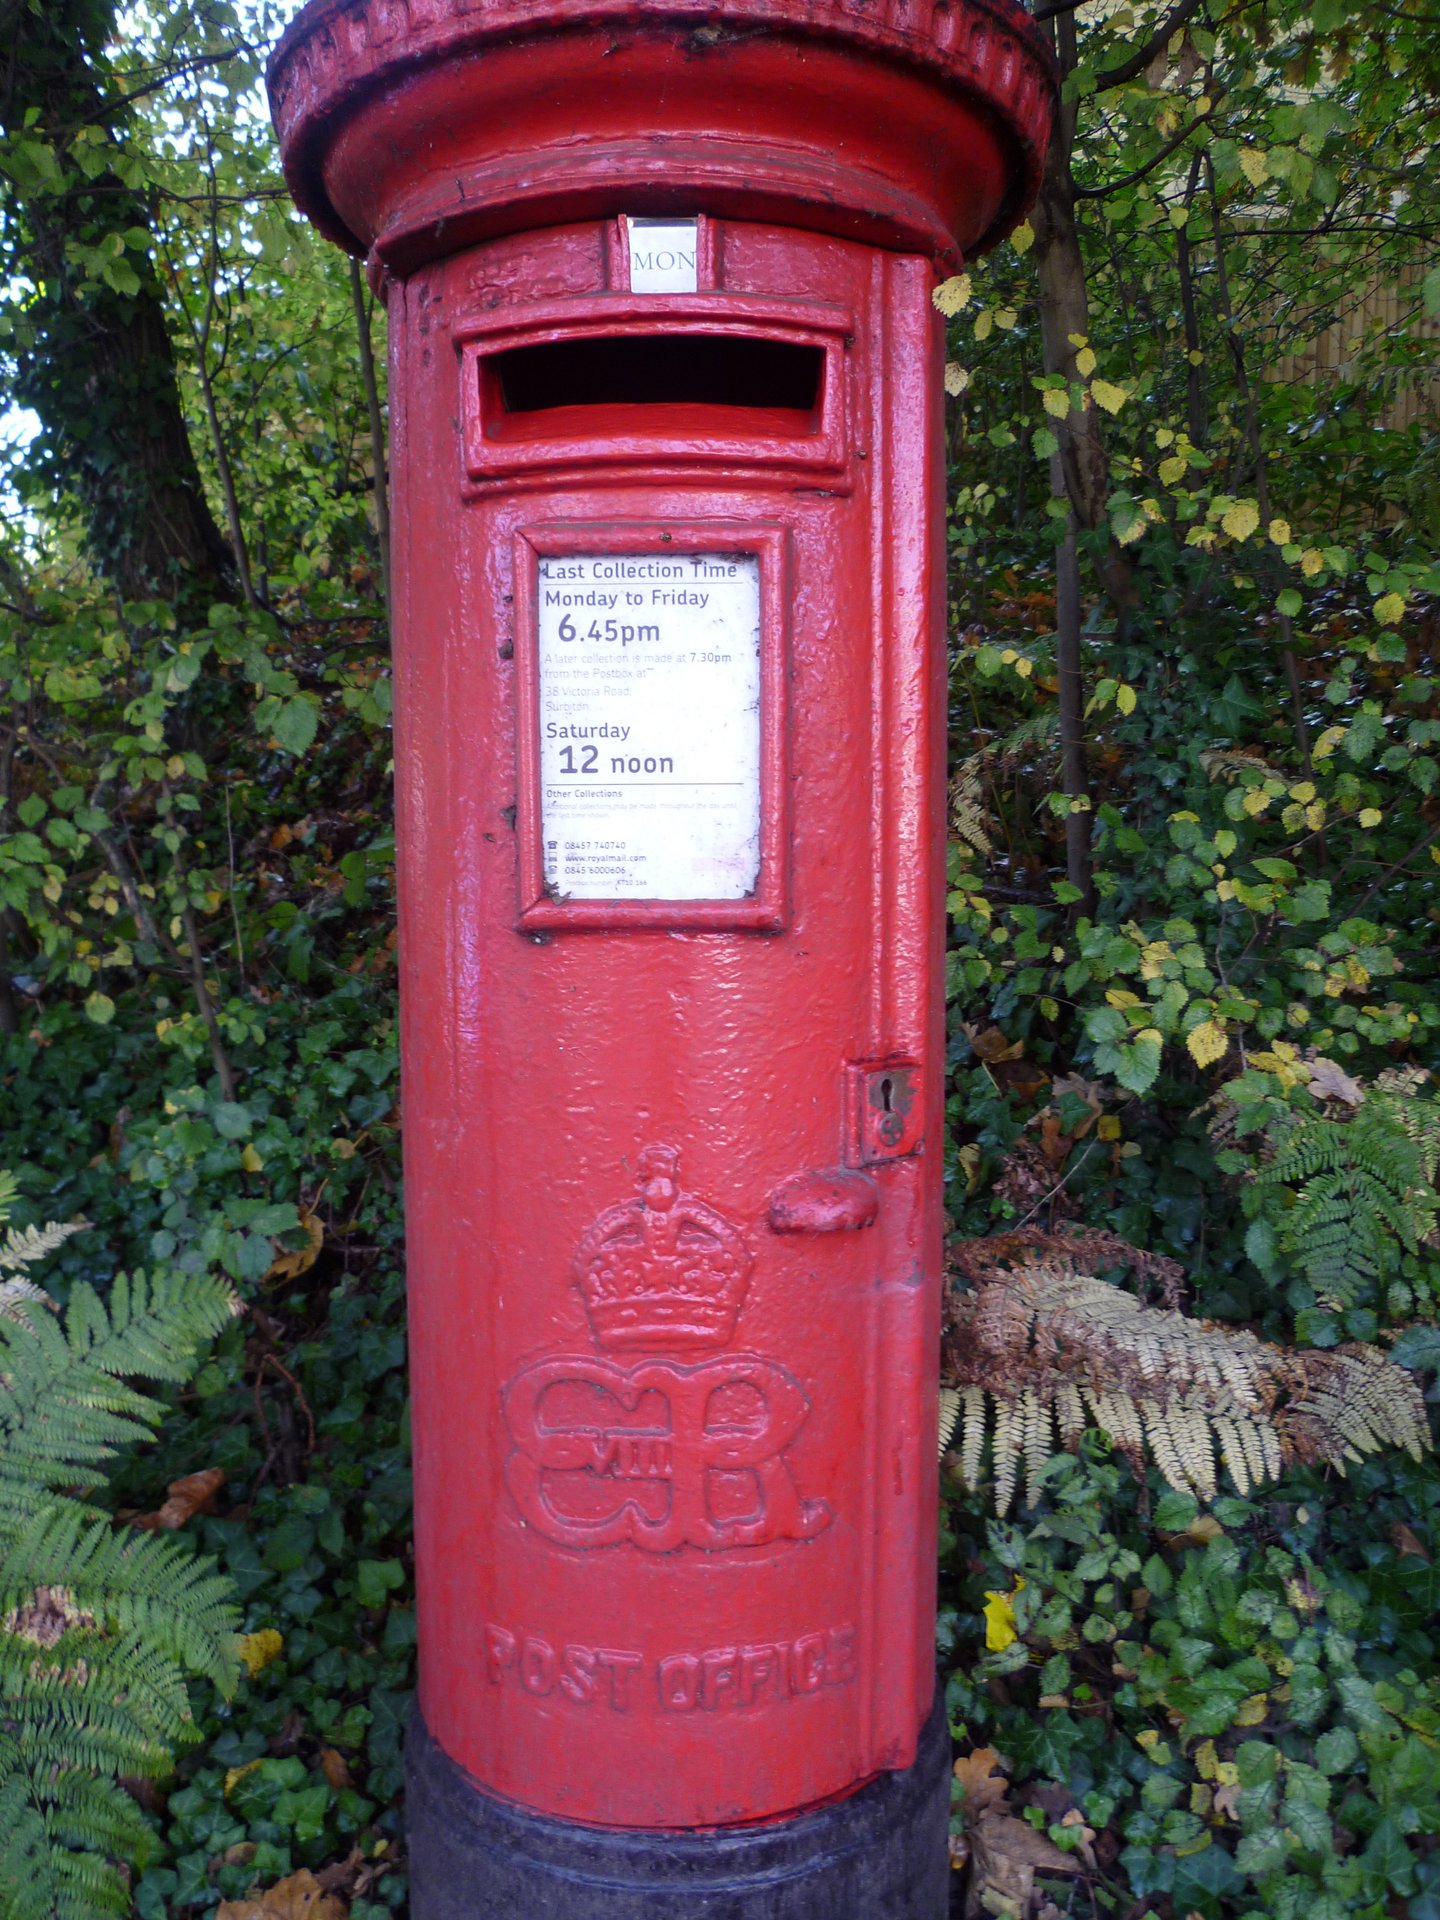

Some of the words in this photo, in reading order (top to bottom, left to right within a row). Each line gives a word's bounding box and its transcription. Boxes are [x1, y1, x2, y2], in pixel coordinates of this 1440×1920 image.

[633, 251, 697, 271] MON
[545, 563, 585, 579] Last
[592, 562, 684, 578] Collection
[690, 561, 737, 578] Time
[545, 590, 618, 609] Monday
[626, 591, 643, 606] to
[652, 589, 710, 609] Friday
[558, 613, 660, 647] 6.45pm
[544, 653, 552, 664] A
[555, 653, 578, 664] later
[582, 652, 629, 664] collection
[633, 653, 641, 664] is
[644, 653, 673, 664] made
[676, 653, 687, 664] at
[690, 652, 732, 665] 7.30pm
[544, 668, 569, 679] from
[573, 668, 590, 679] the
[546, 722, 631, 742] Saturday
[559, 745, 599, 774] 12
[610, 756, 674, 774] noon
[546, 789, 572, 798] Other
[575, 789, 623, 798] Collections
[565, 841, 591, 850] 08457
[594, 841, 626, 850] 740740
[565, 854, 648, 864] www.royalmail.com
[565, 866, 586, 875] 0845
[487, 1623, 644, 1713] POST
[658, 1622, 857, 1714] OFFICE
